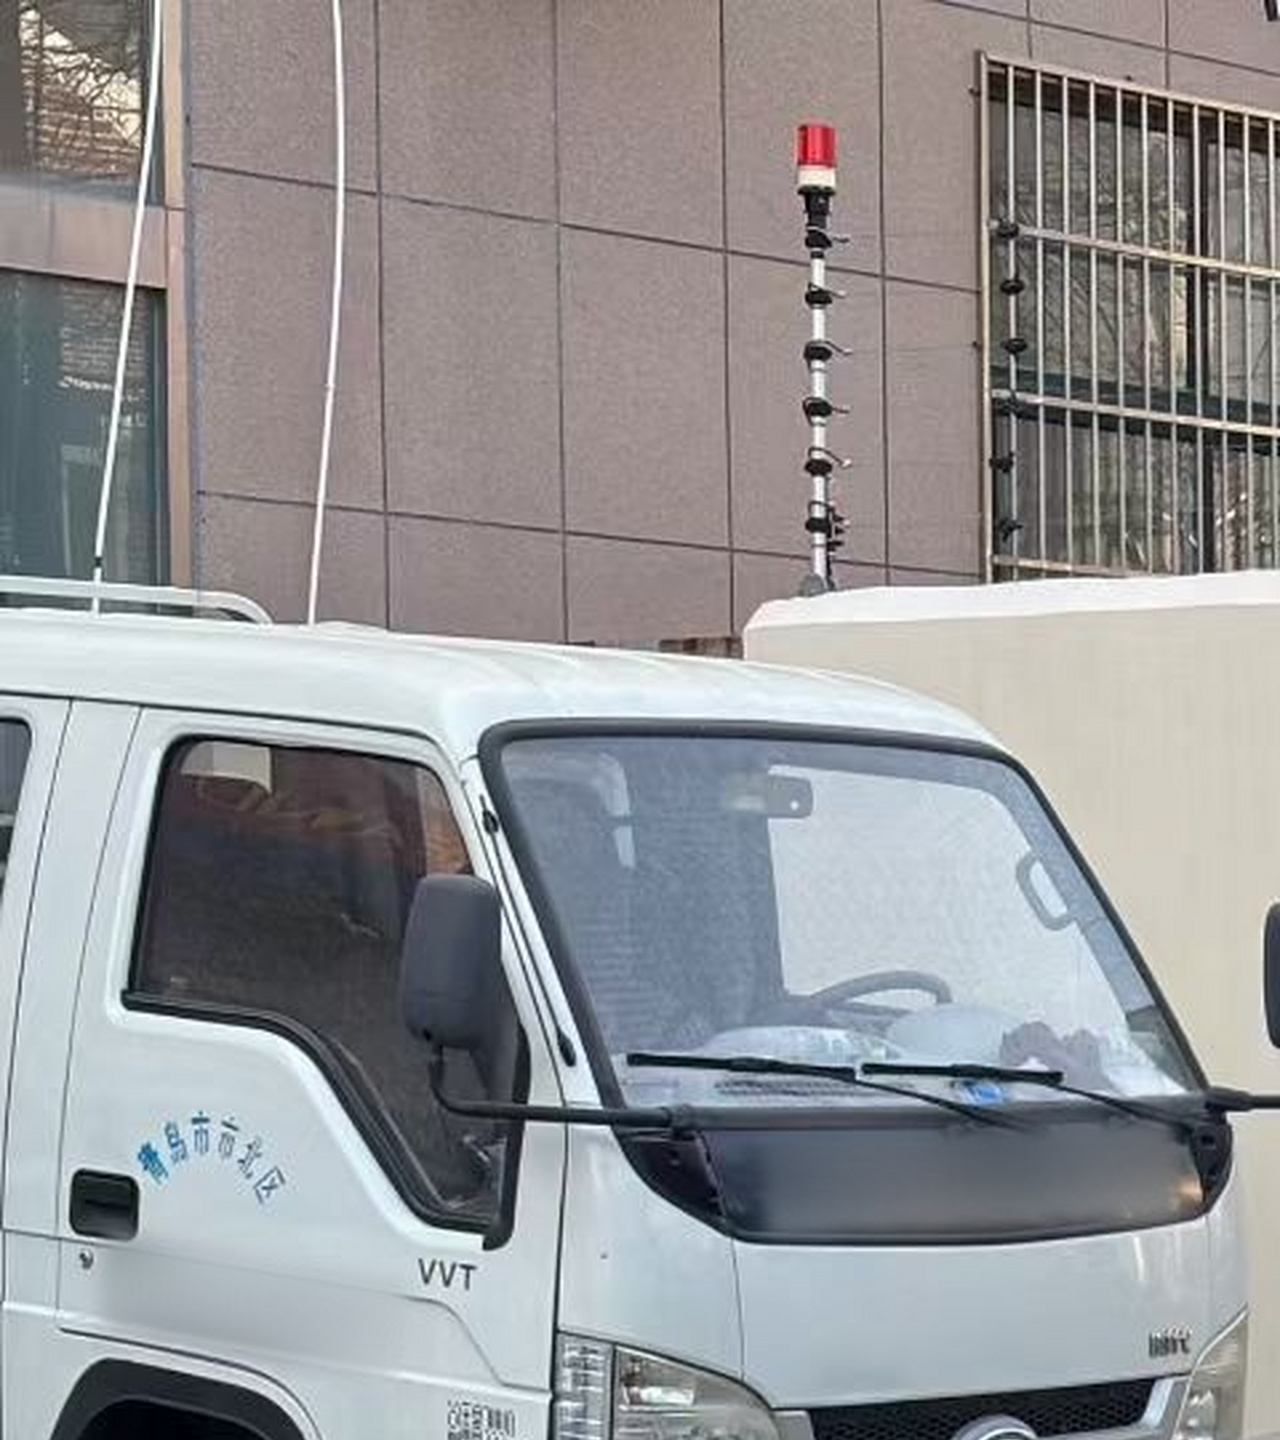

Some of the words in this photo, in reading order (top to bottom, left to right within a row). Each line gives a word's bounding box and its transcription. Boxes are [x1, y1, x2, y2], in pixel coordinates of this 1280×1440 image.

[138, 1110, 285, 1204] 青岛市市北区
[418, 1258, 477, 1291] VVT
